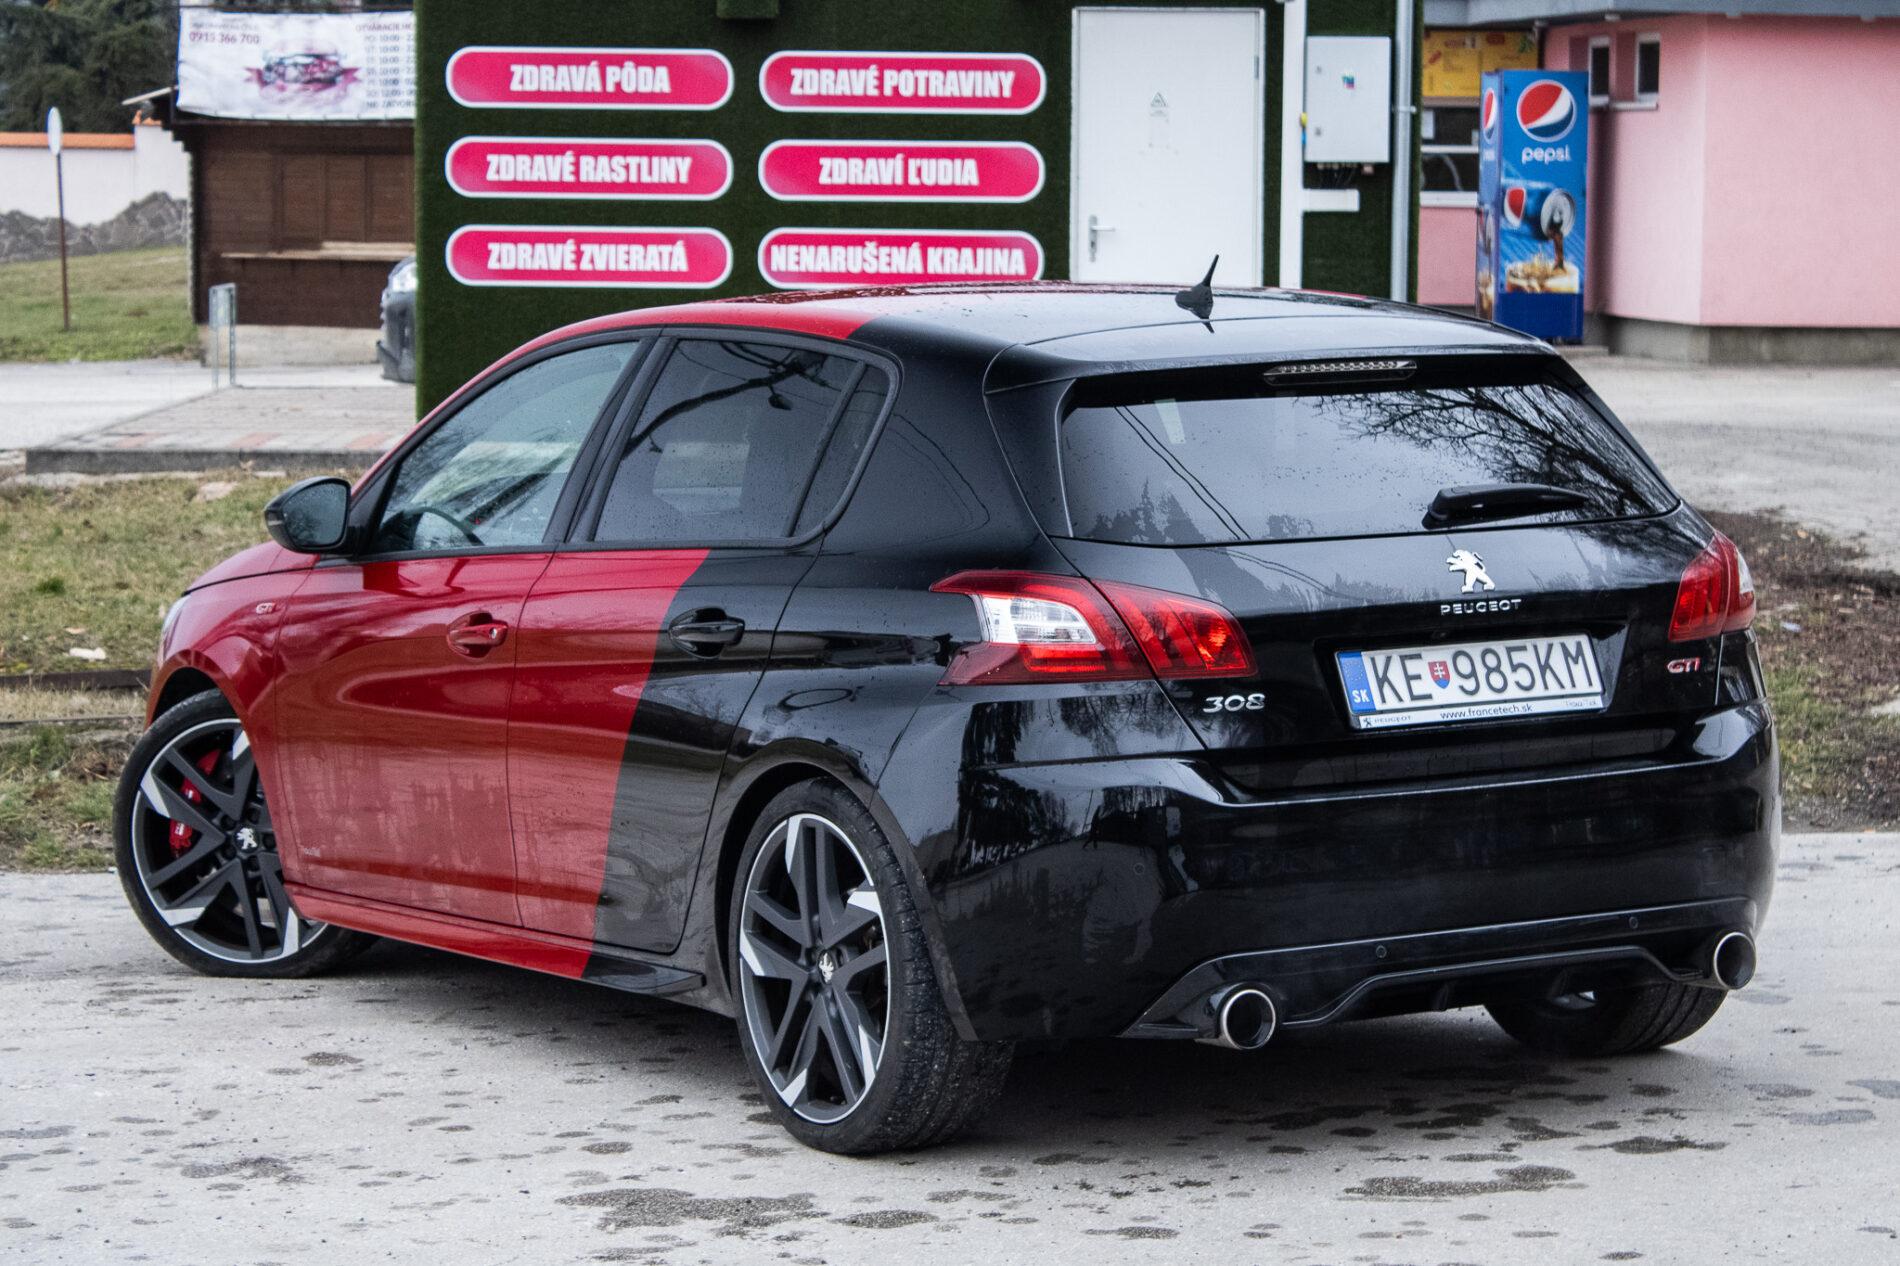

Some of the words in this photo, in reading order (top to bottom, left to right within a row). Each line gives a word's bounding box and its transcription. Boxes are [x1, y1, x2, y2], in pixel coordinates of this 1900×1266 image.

[189, 31, 215, 42] 0915
[219, 33, 237, 44] 366
[240, 33, 260, 45] 700
[510, 61, 602, 92] ZDRAVÁ
[606, 61, 671, 93] PÔDA
[790, 65, 880, 96] ZDRAVÉ
[883, 69, 1015, 98] POTRAVINY
[486, 150, 576, 182] ZDRAVÉ
[579, 155, 692, 184] RASTLINY
[1521, 145, 1571, 165] pepsi
[819, 154, 904, 185] ZDRAVÍ
[908, 158, 979, 186] ĽUDIA
[487, 239, 577, 270] ZDRAVÉ
[580, 240, 689, 272] ZVIERATÁ
[771, 241, 924, 273] NENARUŠENÁ
[927, 247, 1027, 275] KRAJINA
[1440, 599, 1522, 615] PEUGEOT
[1370, 653, 1433, 704] KE
[1452, 640, 1593, 696] 985KM
[1667, 657, 1700, 674] GTI
[1203, 693, 1266, 713] 308
[1352, 689, 1370, 703] SK
[1440, 703, 1535, 719] www.francetech.sk
